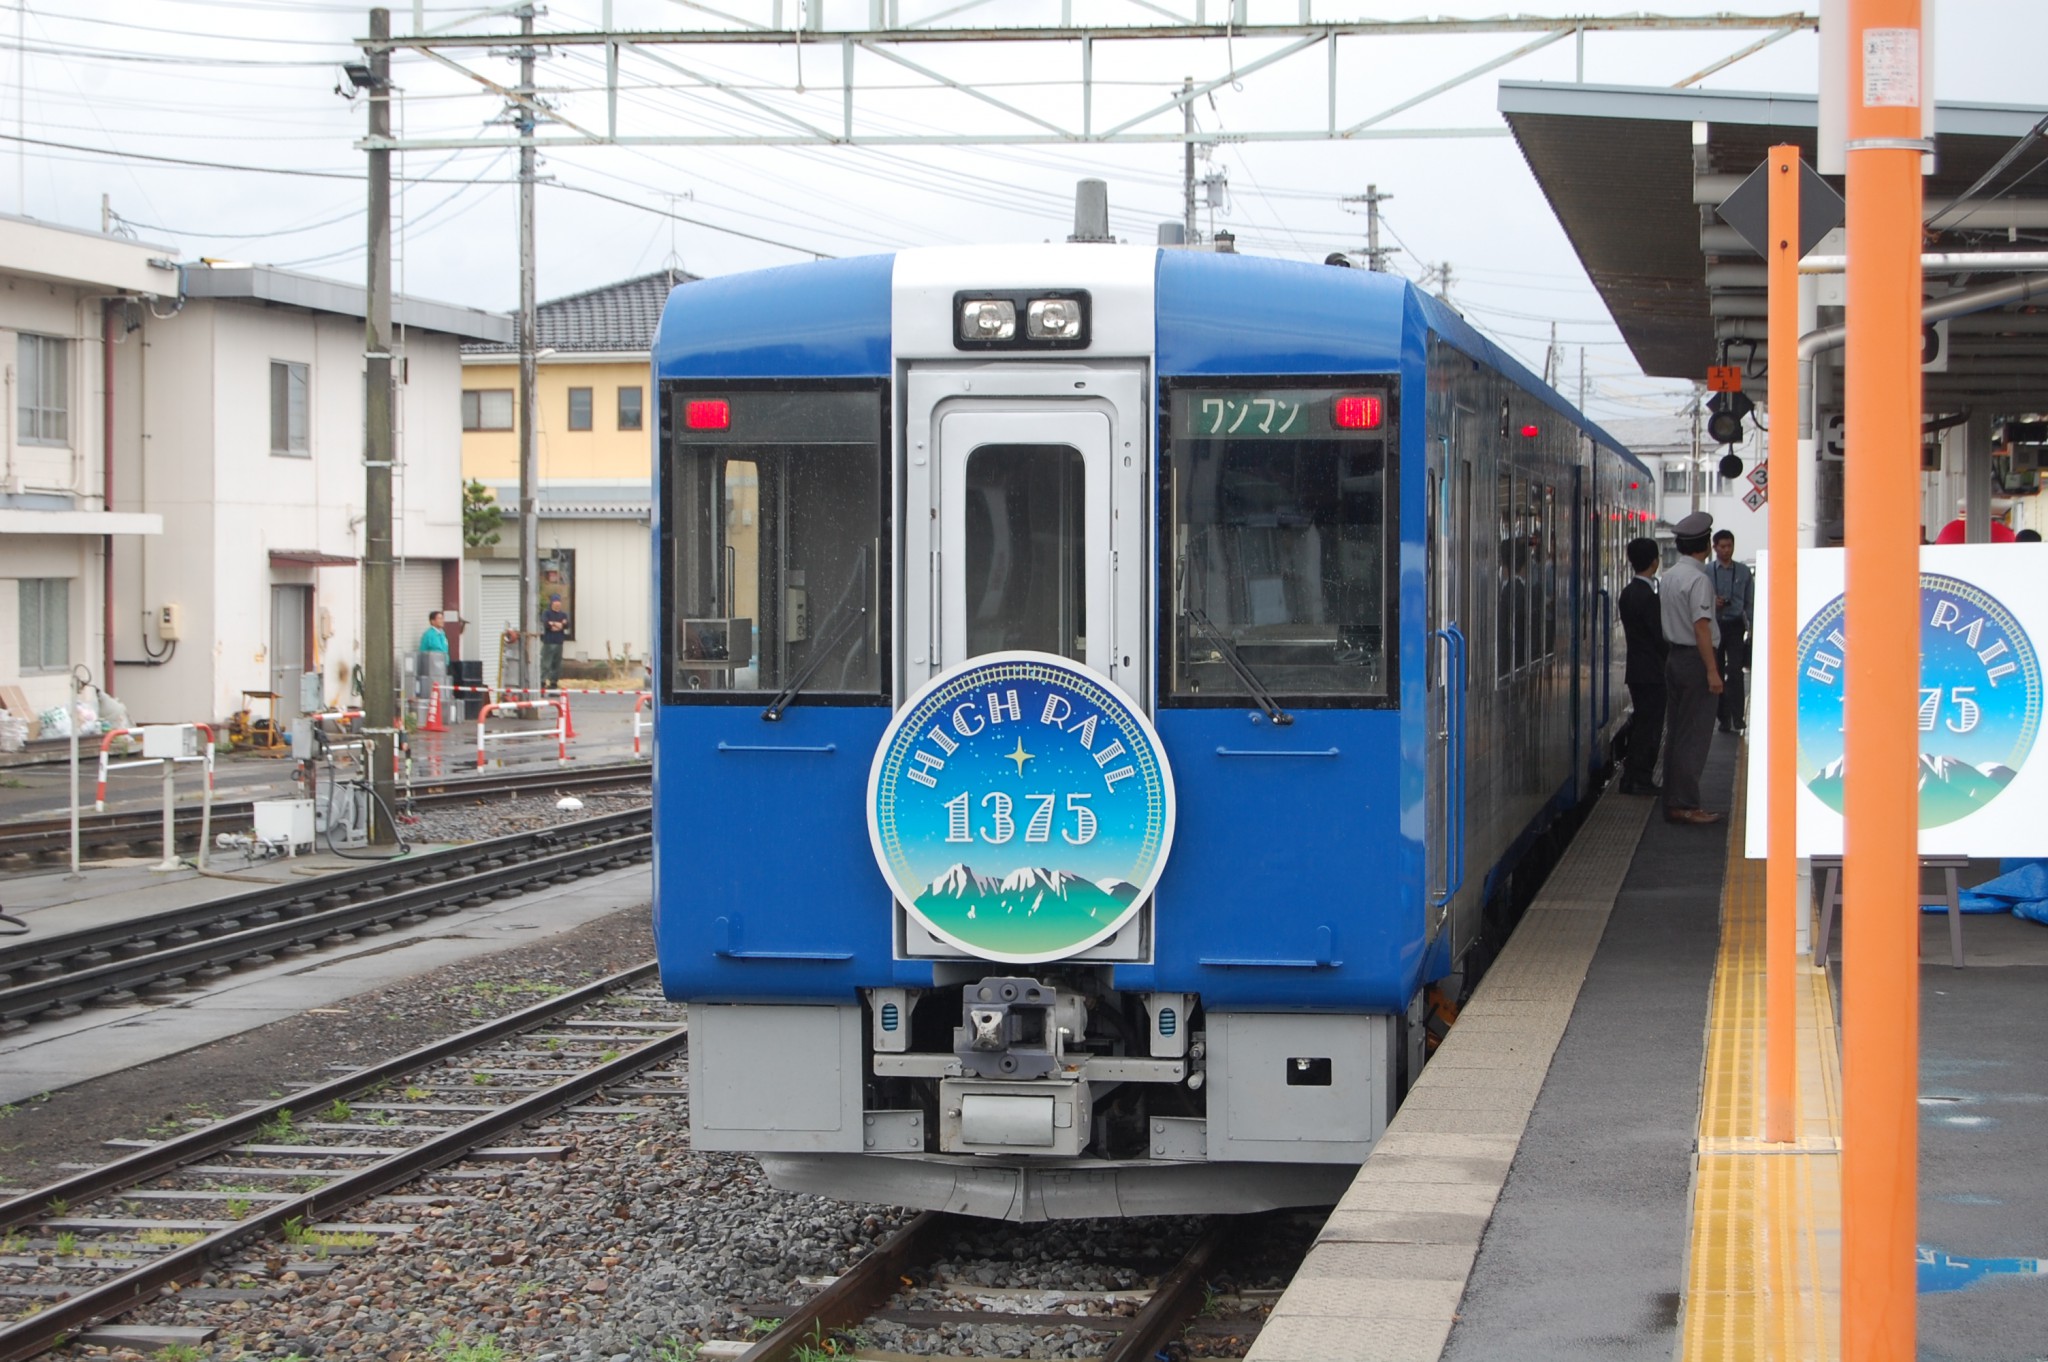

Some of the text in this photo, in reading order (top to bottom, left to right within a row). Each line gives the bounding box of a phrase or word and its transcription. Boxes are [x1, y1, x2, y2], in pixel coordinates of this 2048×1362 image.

[1202, 398, 1300, 434] ワンマン
[1748, 494, 1758, 506] 4
[1755, 470, 1767, 485] 3
[1930, 599, 2016, 688] RAIL
[907, 689, 1135, 793] HIGH RAIL
[943, 791, 1098, 845] 1375
